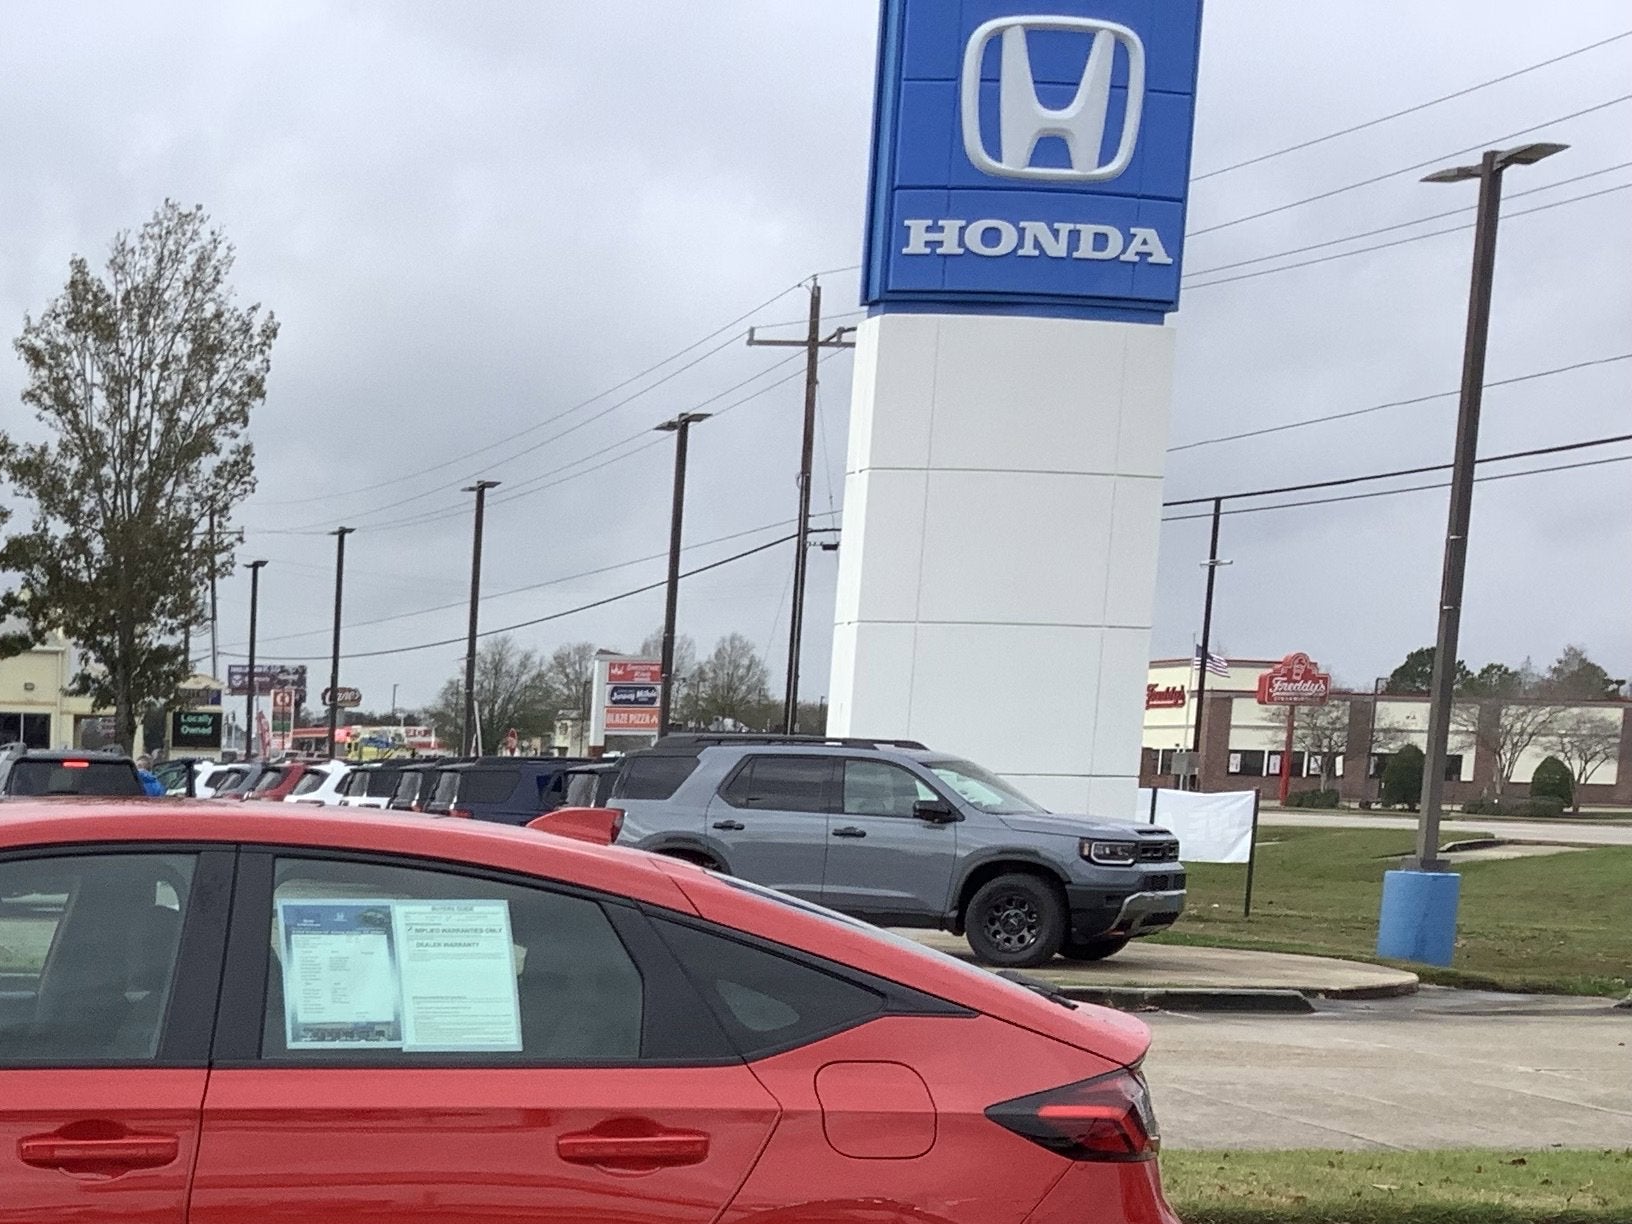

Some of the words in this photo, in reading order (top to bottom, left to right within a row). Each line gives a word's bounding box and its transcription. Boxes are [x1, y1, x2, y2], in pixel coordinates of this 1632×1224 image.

[901, 218, 1174, 265] HONDA
[1270, 676, 1326, 697] Freddy's
[180, 714, 214, 726] Locally
[629, 713, 651, 724] PIZZA
[180, 726, 213, 735] Owned
